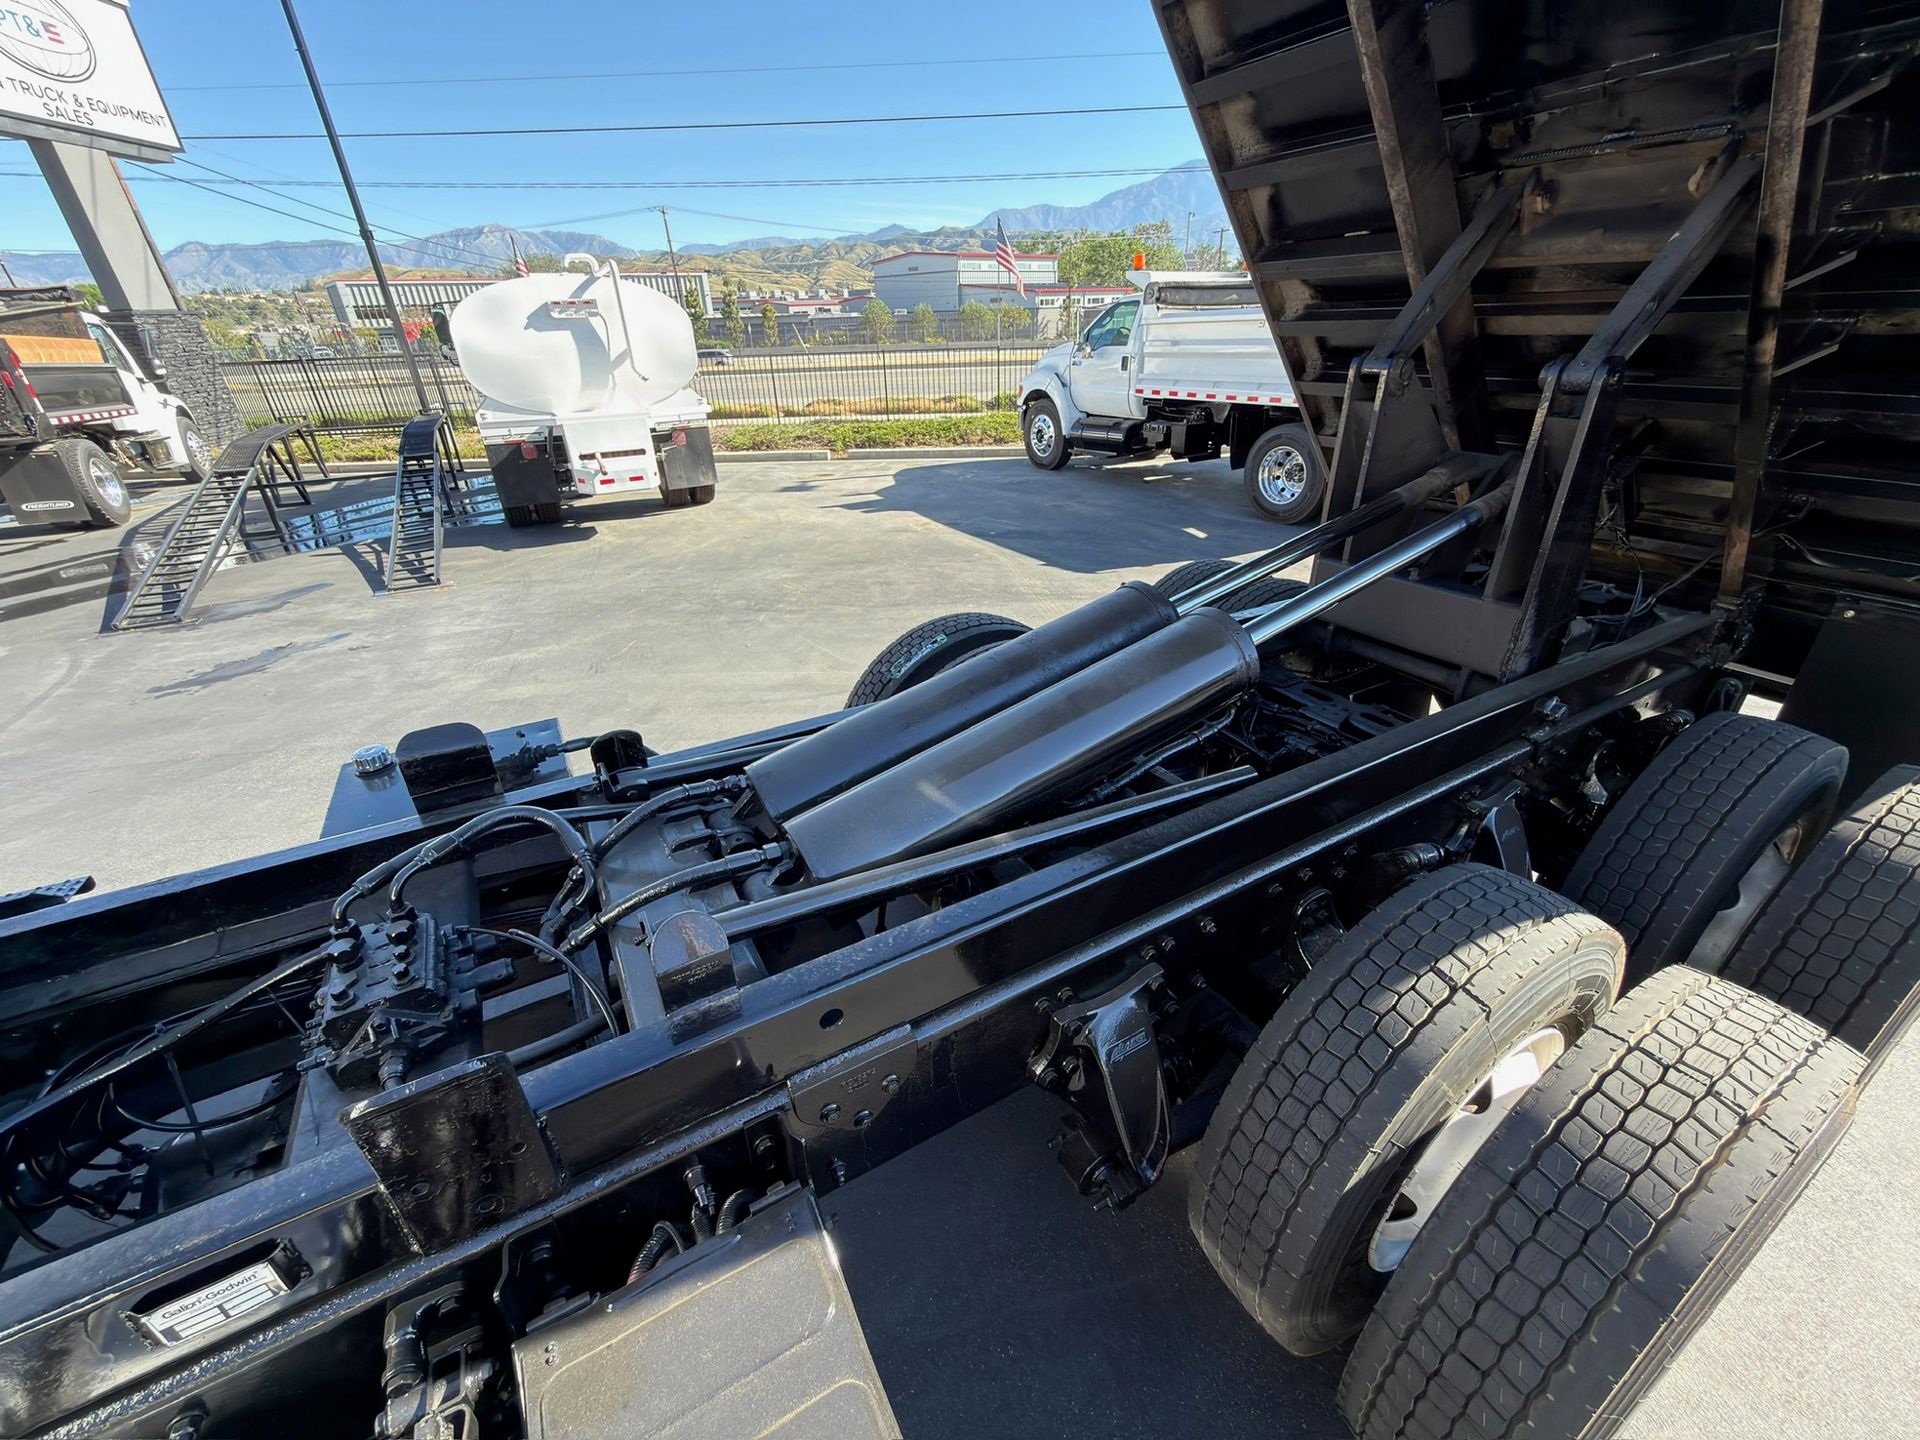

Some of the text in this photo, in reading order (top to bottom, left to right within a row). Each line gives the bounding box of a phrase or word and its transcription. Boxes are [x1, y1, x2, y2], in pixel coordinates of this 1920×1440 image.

[6, 77, 167, 128] TRUCK & EQUIPMENT
[43, 102, 94, 126] SALES
